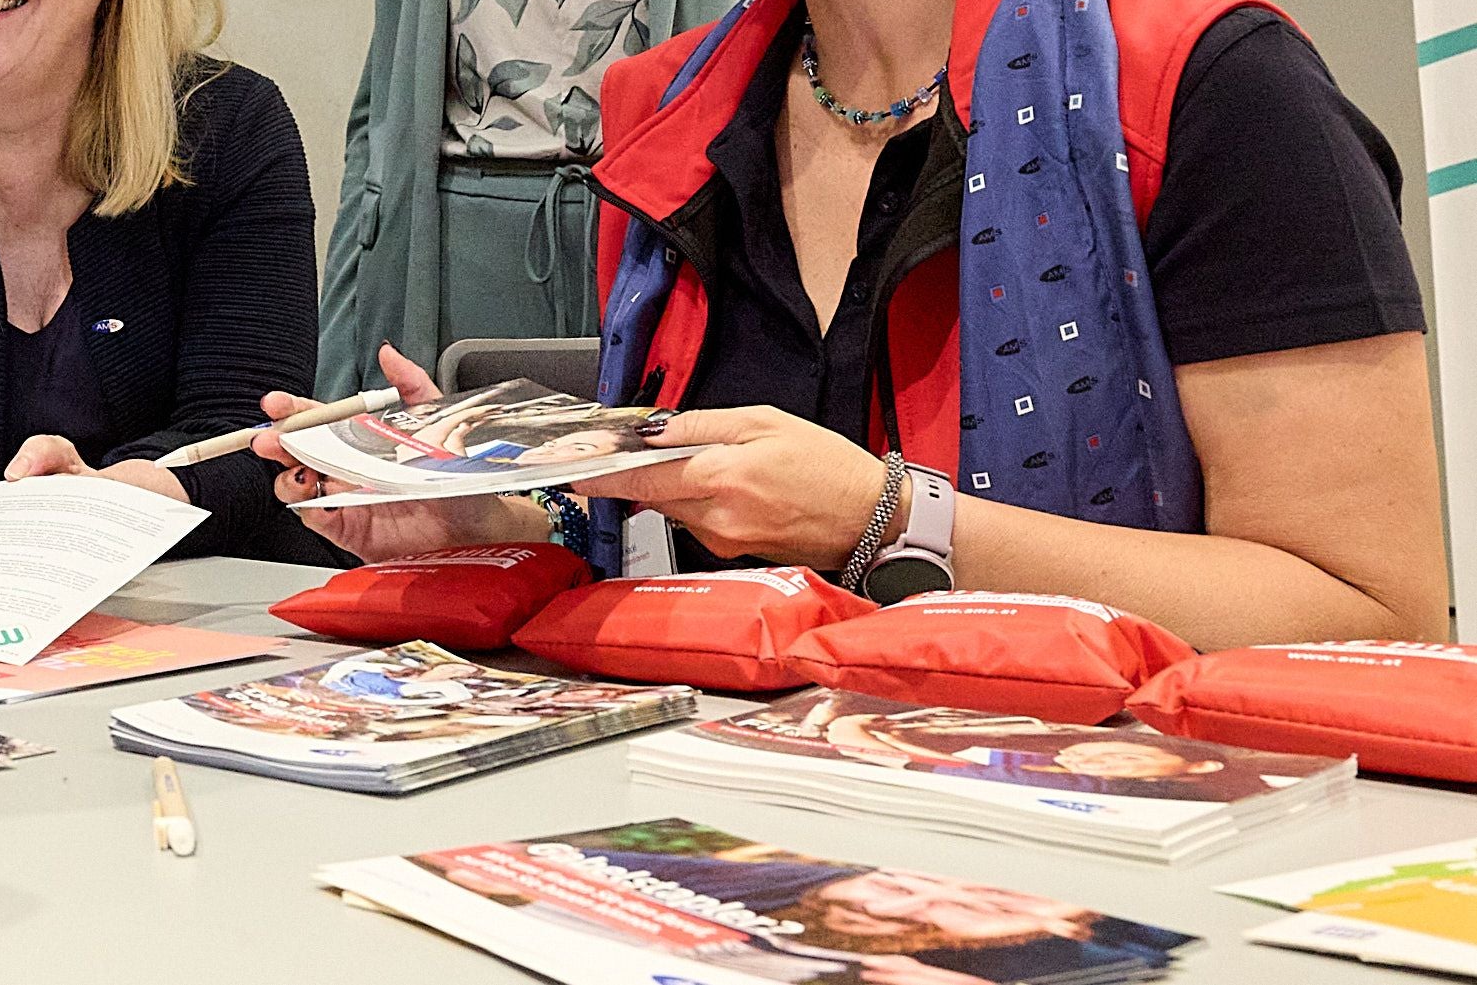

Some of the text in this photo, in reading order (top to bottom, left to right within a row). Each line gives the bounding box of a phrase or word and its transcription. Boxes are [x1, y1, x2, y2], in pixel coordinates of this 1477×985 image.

[633, 575, 712, 594] www.ams.at
[923, 608, 1018, 616] www.ams.at
[1287, 652, 1403, 667] www.ams.at
